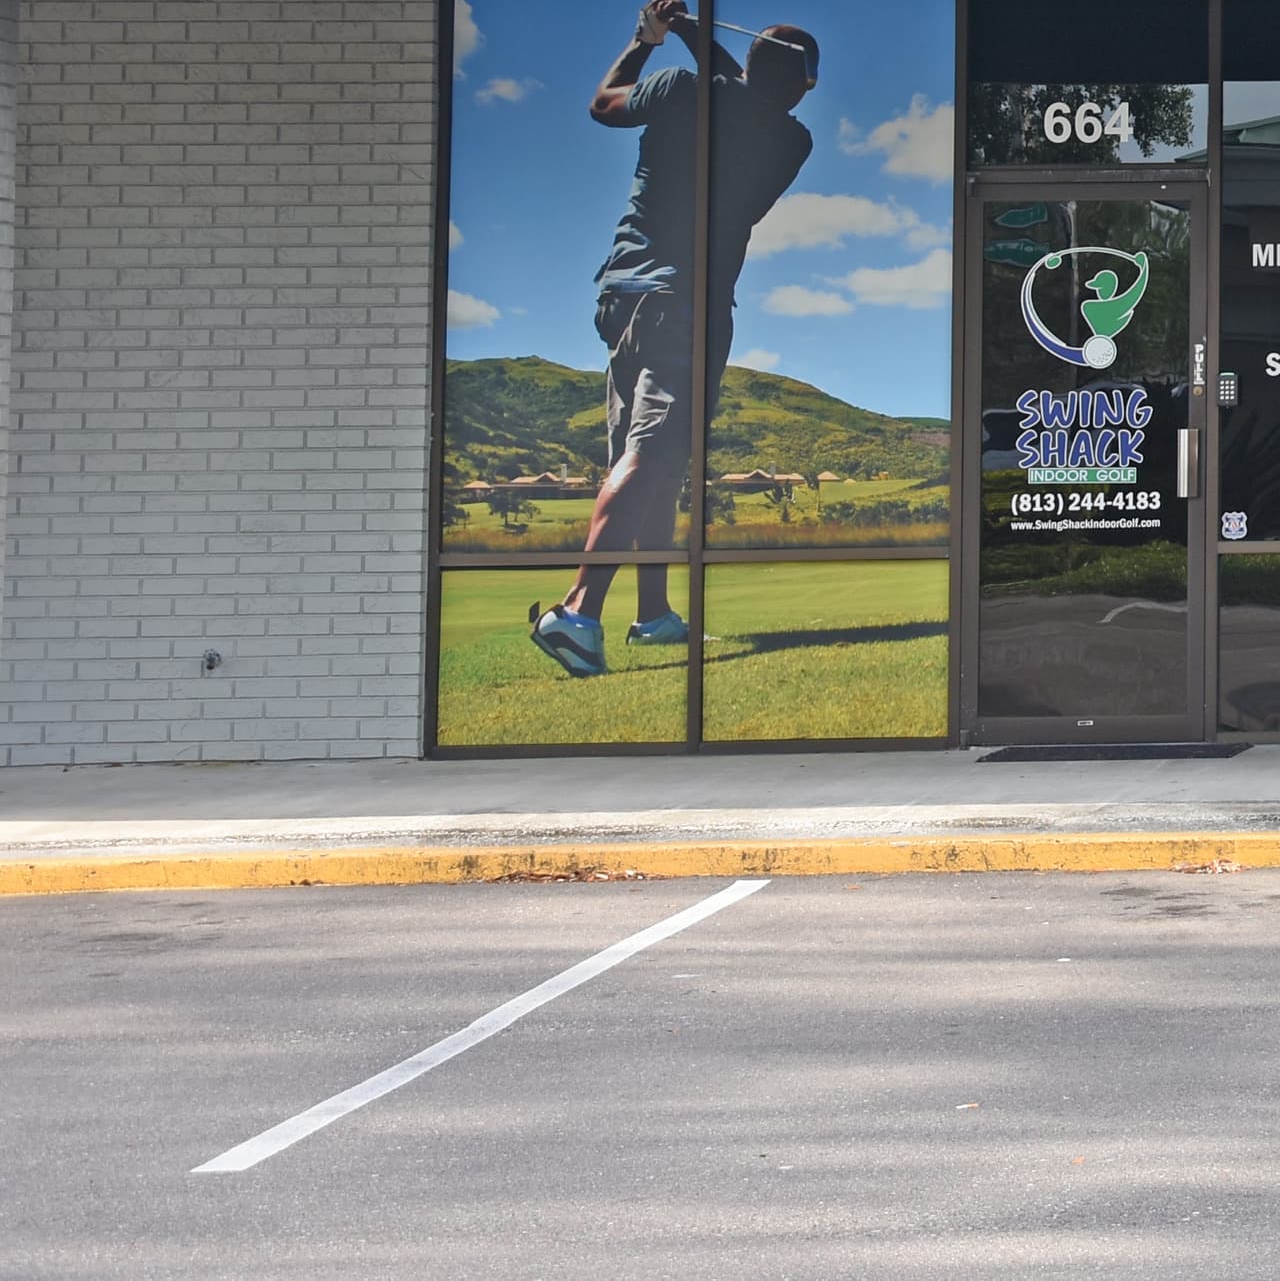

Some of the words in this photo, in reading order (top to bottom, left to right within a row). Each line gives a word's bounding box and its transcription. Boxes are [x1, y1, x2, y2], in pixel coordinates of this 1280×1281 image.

[1043, 101, 1134, 144] 664
[1016, 390, 1153, 429] SWING
[1016, 430, 1145, 469] SHACK
[1030, 470, 1088, 482] INDOOR
[1096, 470, 1135, 481] GOLF
[1011, 494, 1064, 515] (813)
[1068, 491, 1161, 511] 244-4183
[1011, 518, 1161, 531] www.SwingShackIndoorGolf.com
